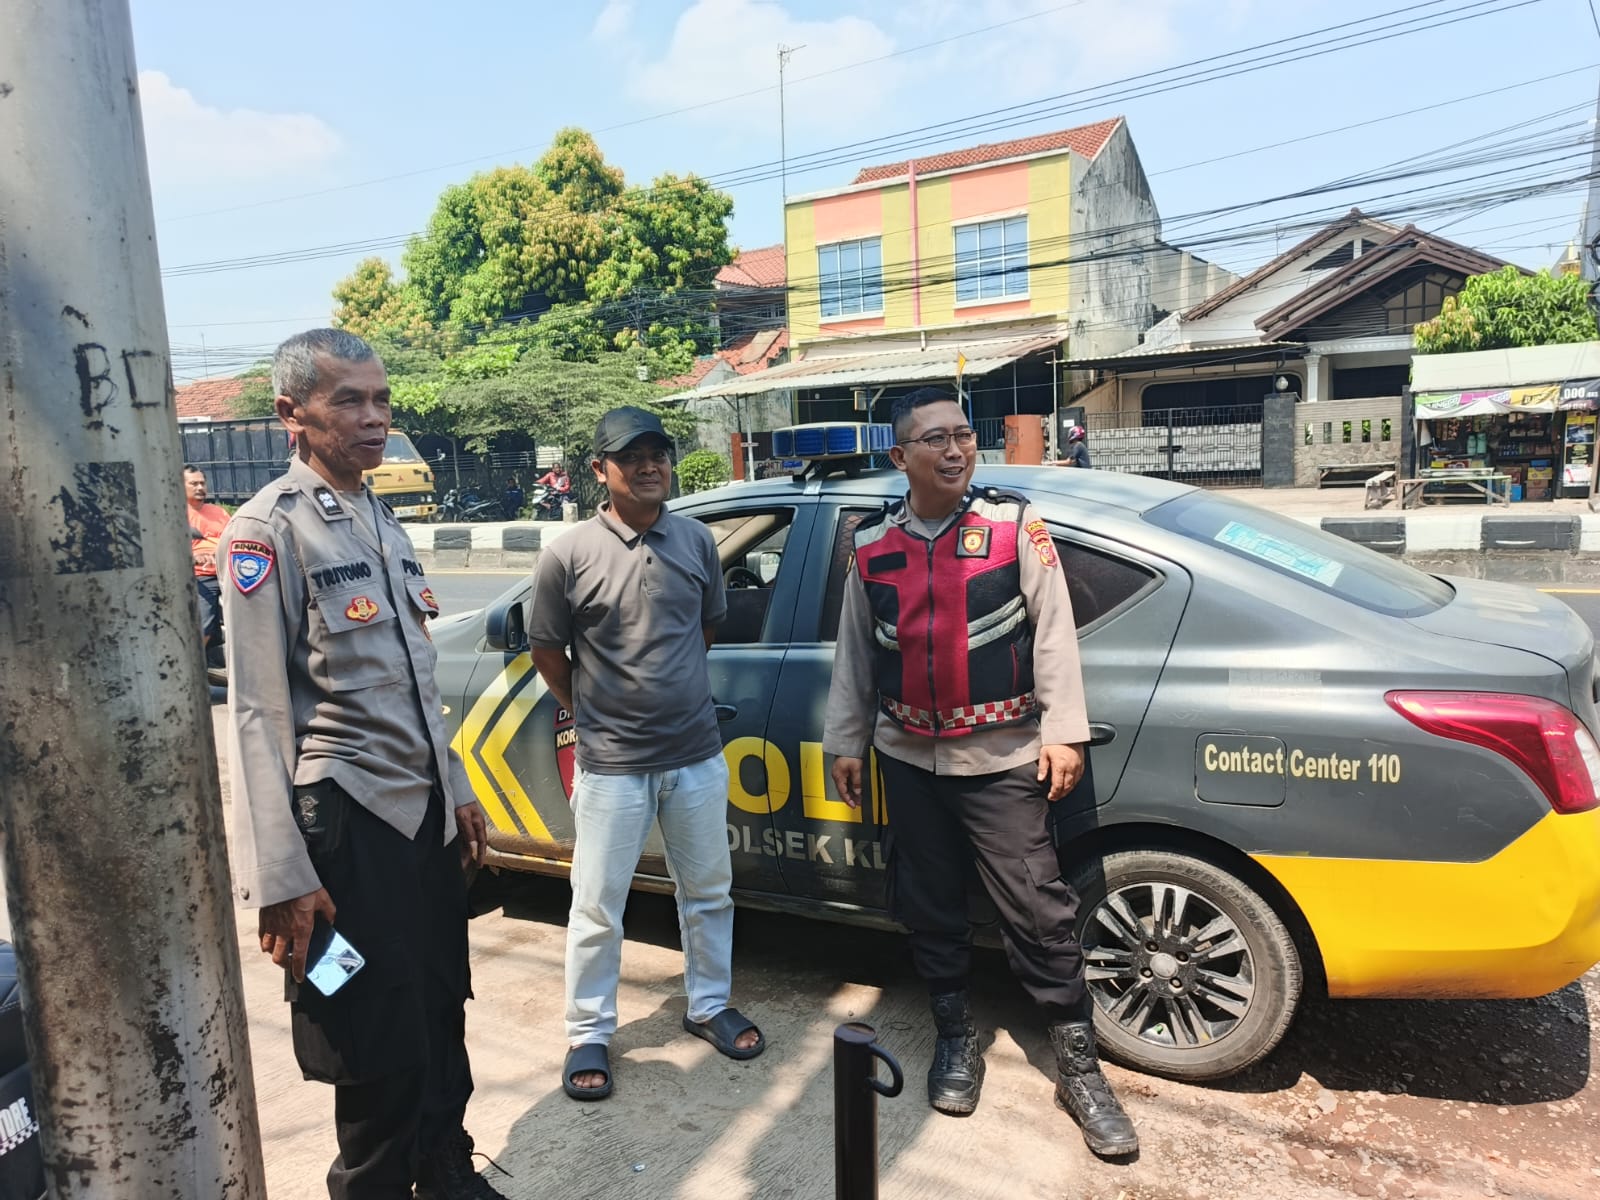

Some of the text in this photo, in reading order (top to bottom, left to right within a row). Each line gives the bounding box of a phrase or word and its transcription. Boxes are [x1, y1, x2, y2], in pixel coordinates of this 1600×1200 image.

[311, 561, 371, 589] TRIYONO
[401, 558, 425, 577] POLI
[556, 729, 578, 747] KOR
[1204, 743, 1401, 784] Contact Center 110
[722, 736, 888, 826] OLI
[726, 823, 888, 870] OLSEK KL
